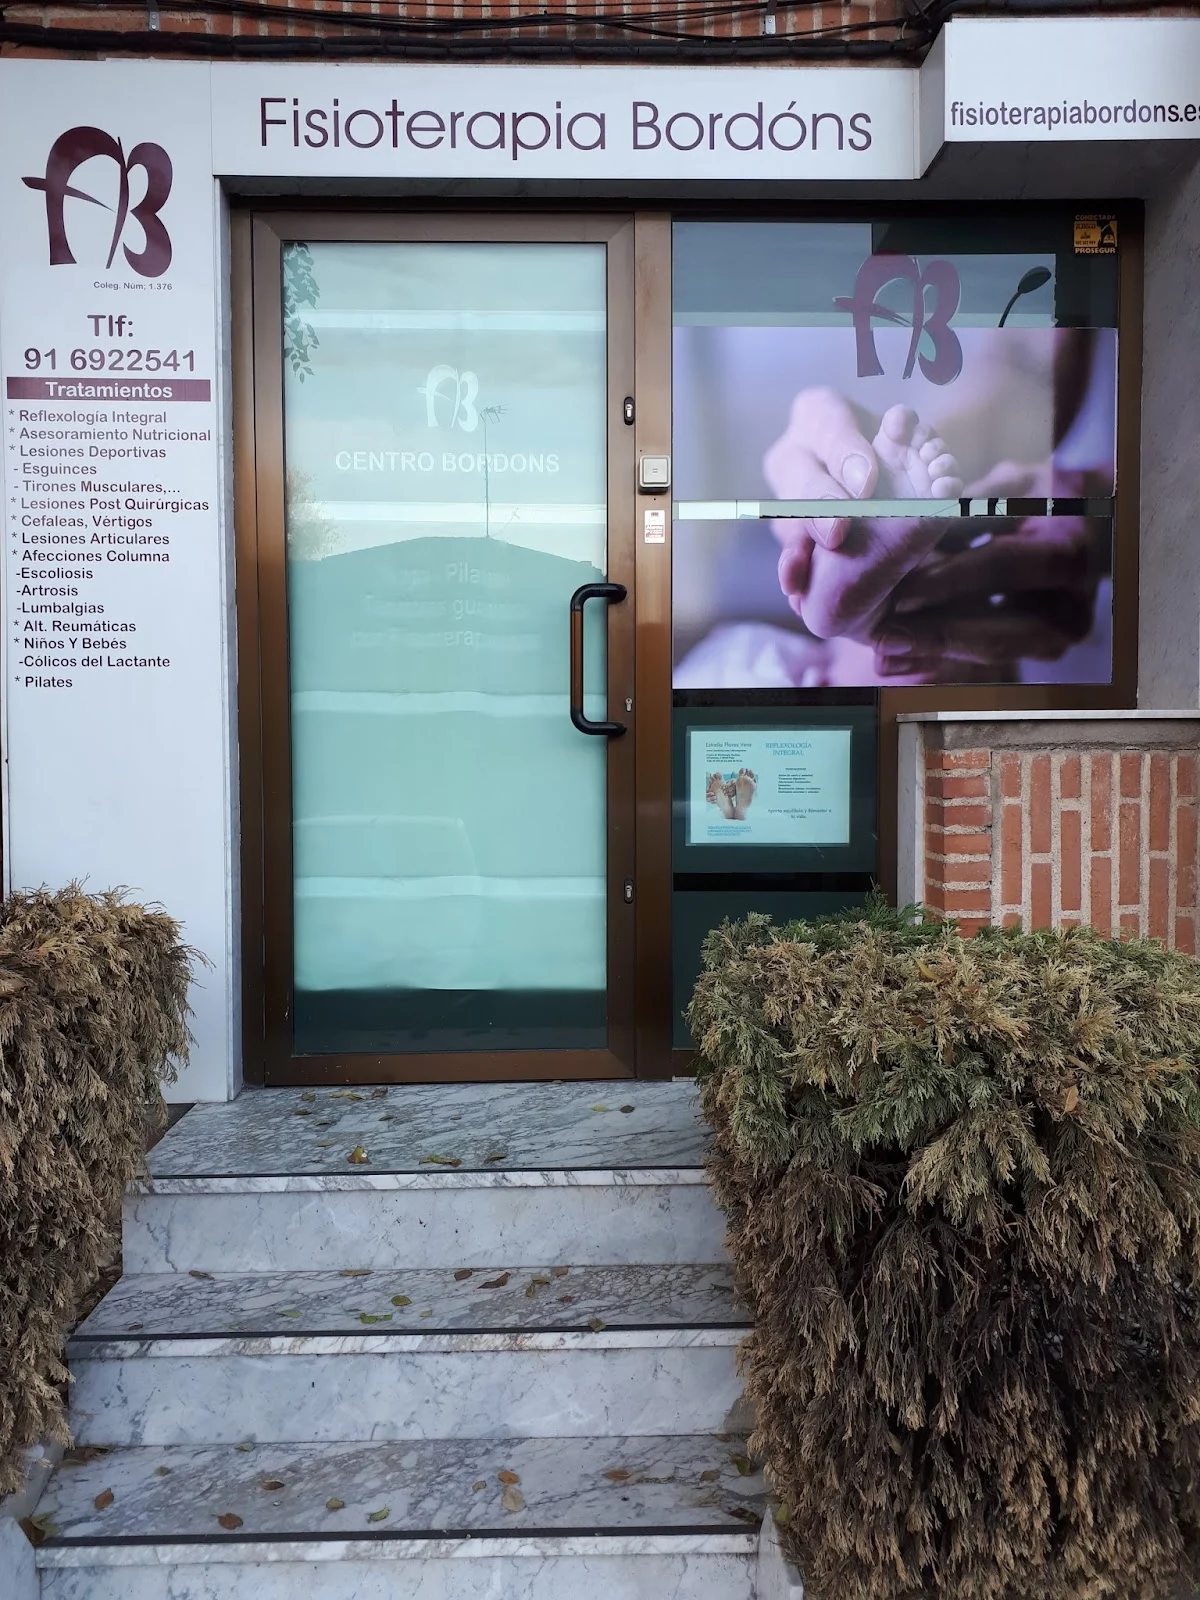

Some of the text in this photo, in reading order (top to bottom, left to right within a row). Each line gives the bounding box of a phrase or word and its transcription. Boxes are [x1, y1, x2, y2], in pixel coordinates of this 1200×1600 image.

[951, 99, 1200, 130] fisioterapiabordons.e
[261, 97, 872, 160] Fisioterapia Bordóns
[93, 281, 121, 290] Coleg.
[149, 282, 173, 291] 1.376
[87, 314, 133, 337] Tlf:
[24, 348, 195, 372] 91 6922541
[45, 381, 173, 399] Tratamientos
[19, 410, 167, 425] Reflexología Integral
[19, 427, 211, 442] Asesoramiento Nutricional
[20, 444, 167, 460] Lesiones Deportivas
[22, 462, 97, 477] Esguinces
[335, 450, 560, 474] CENTRO BORDONS
[22, 479, 76, 493] Tirones
[21, 497, 209, 513] Lesiones Post Quirúrgicas
[21, 514, 153, 530] Cefaleas, Vértigos
[22, 532, 170, 545] Lesiones Articulares
[22, 549, 170, 562] Afecciones Columna
[23, 619, 136, 633] Alt. Reumáticas
[24, 636, 127, 650] Niños Y Bebés
[81, 655, 102, 668] del
[107, 655, 170, 668] Lactante
[24, 675, 73, 688] Pilates
[765, 741, 812, 749] REFLEXOLOGÍA
